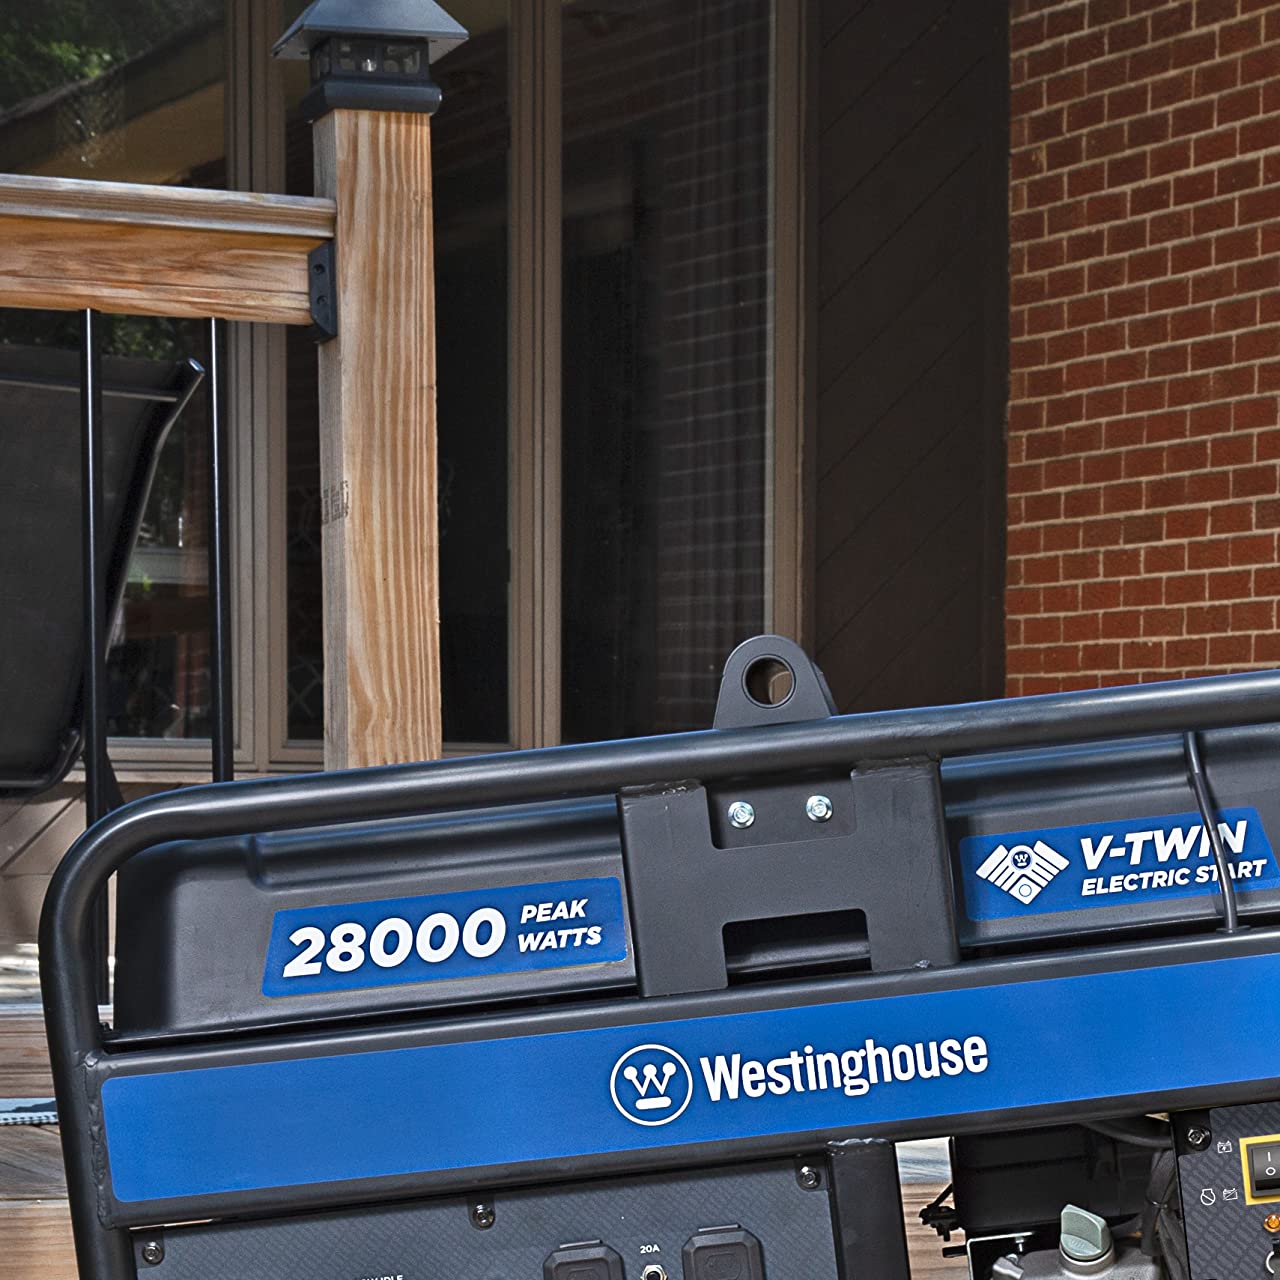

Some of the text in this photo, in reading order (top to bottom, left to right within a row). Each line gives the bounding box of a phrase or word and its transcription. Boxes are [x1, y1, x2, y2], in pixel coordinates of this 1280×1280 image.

[1080, 820, 1248, 870] V-TWIN
[1081, 867, 1191, 896] ELECTRIC
[520, 899, 588, 923] PEAK
[282, 907, 506, 977] 28000
[517, 925, 602, 953] WATTS
[700, 1035, 988, 1102] Westinghouse
[640, 1244, 661, 1254] 20A
